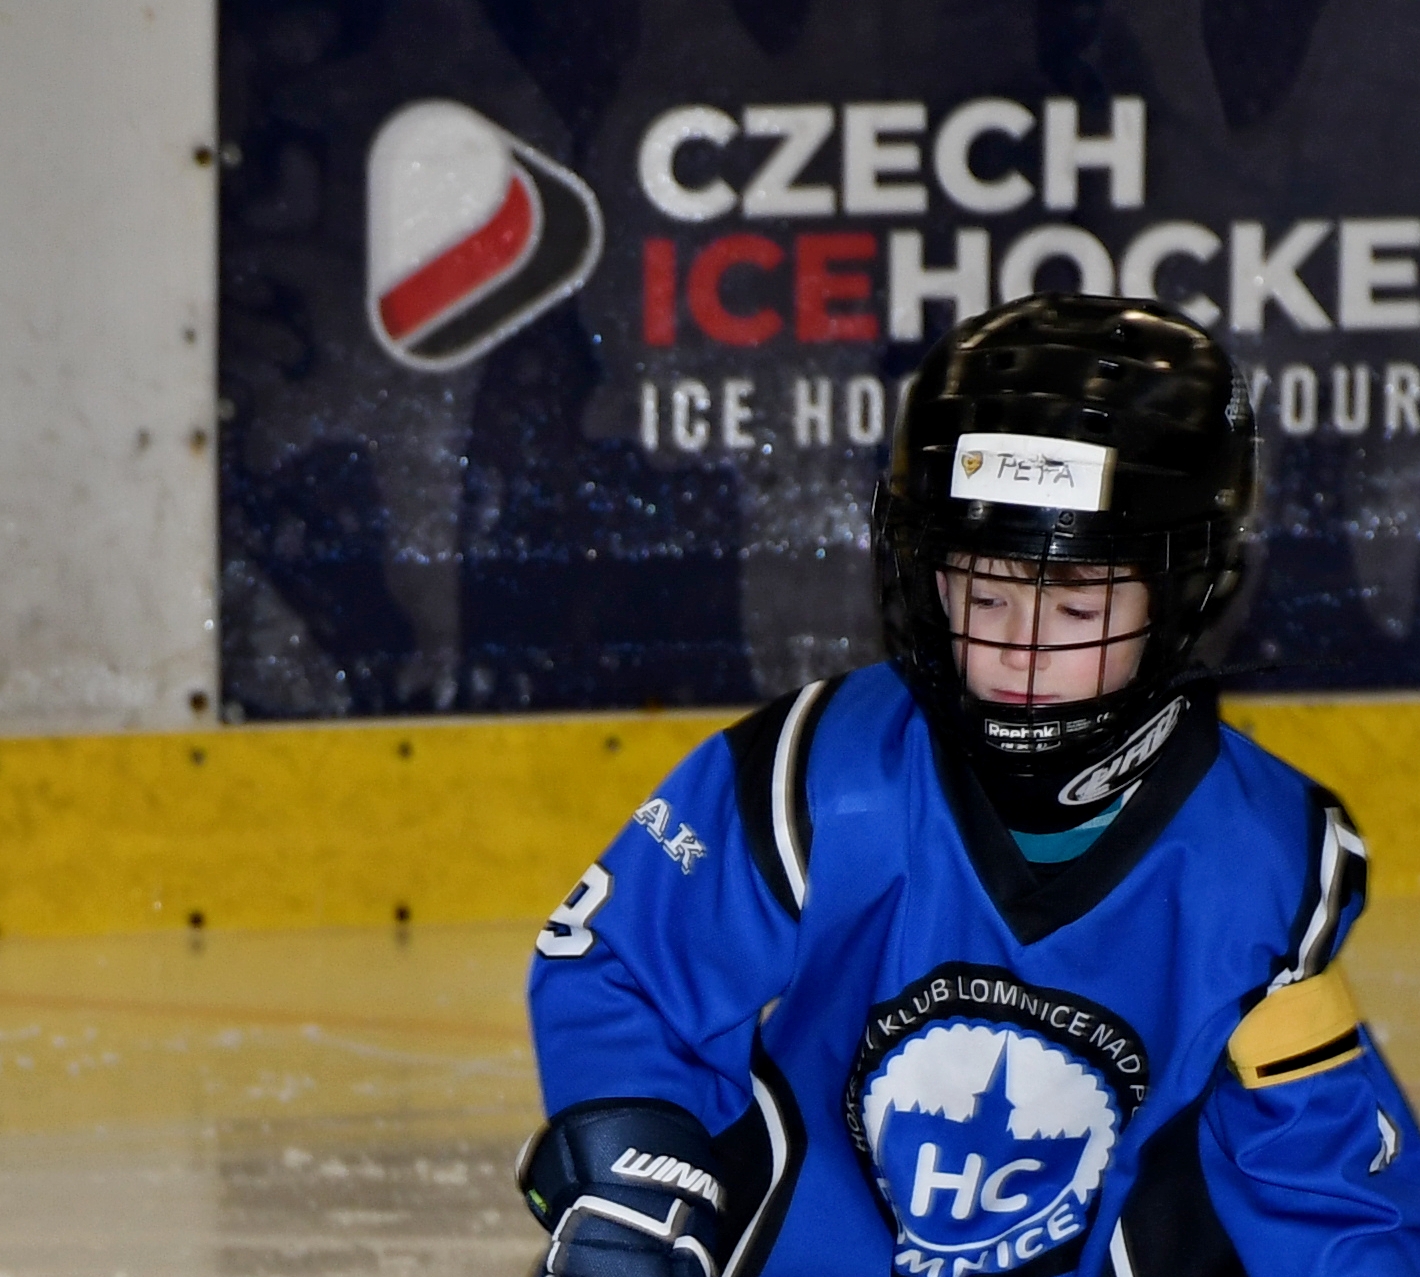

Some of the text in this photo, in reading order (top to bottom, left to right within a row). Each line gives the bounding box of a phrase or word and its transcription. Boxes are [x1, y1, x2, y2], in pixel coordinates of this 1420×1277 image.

[638, 97, 1146, 222] CZECH
[639, 375, 757, 453] ICE
[795, 373, 911, 450] HO
[877, 978, 950, 1036] KLUB
[957, 975, 1091, 1038] LOMNICE
[1088, 1022, 1142, 1075] NAD
[908, 1141, 1044, 1221] HC
